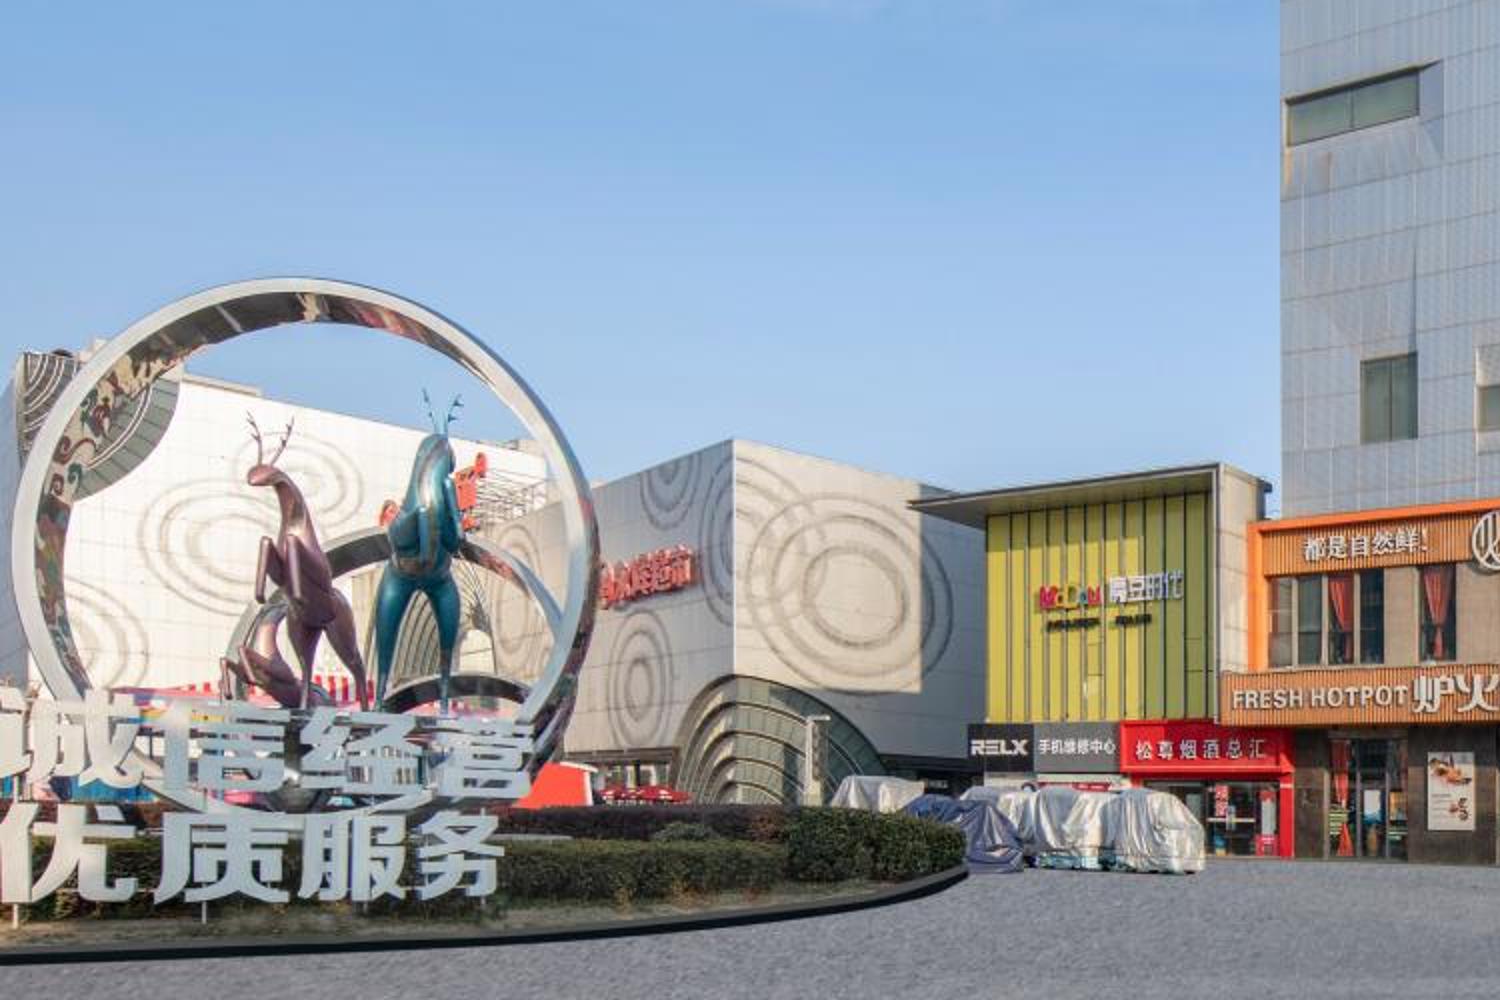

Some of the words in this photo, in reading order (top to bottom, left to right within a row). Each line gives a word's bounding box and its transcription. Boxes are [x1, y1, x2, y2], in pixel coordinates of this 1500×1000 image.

[1232, 687, 1303, 710] FRESH
[1311, 684, 1408, 708] HOTPOT
[971, 739, 1029, 756] RELX
[1039, 738, 1116, 756] 手机维修中心
[0, 801, 505, 904] 优质服务
